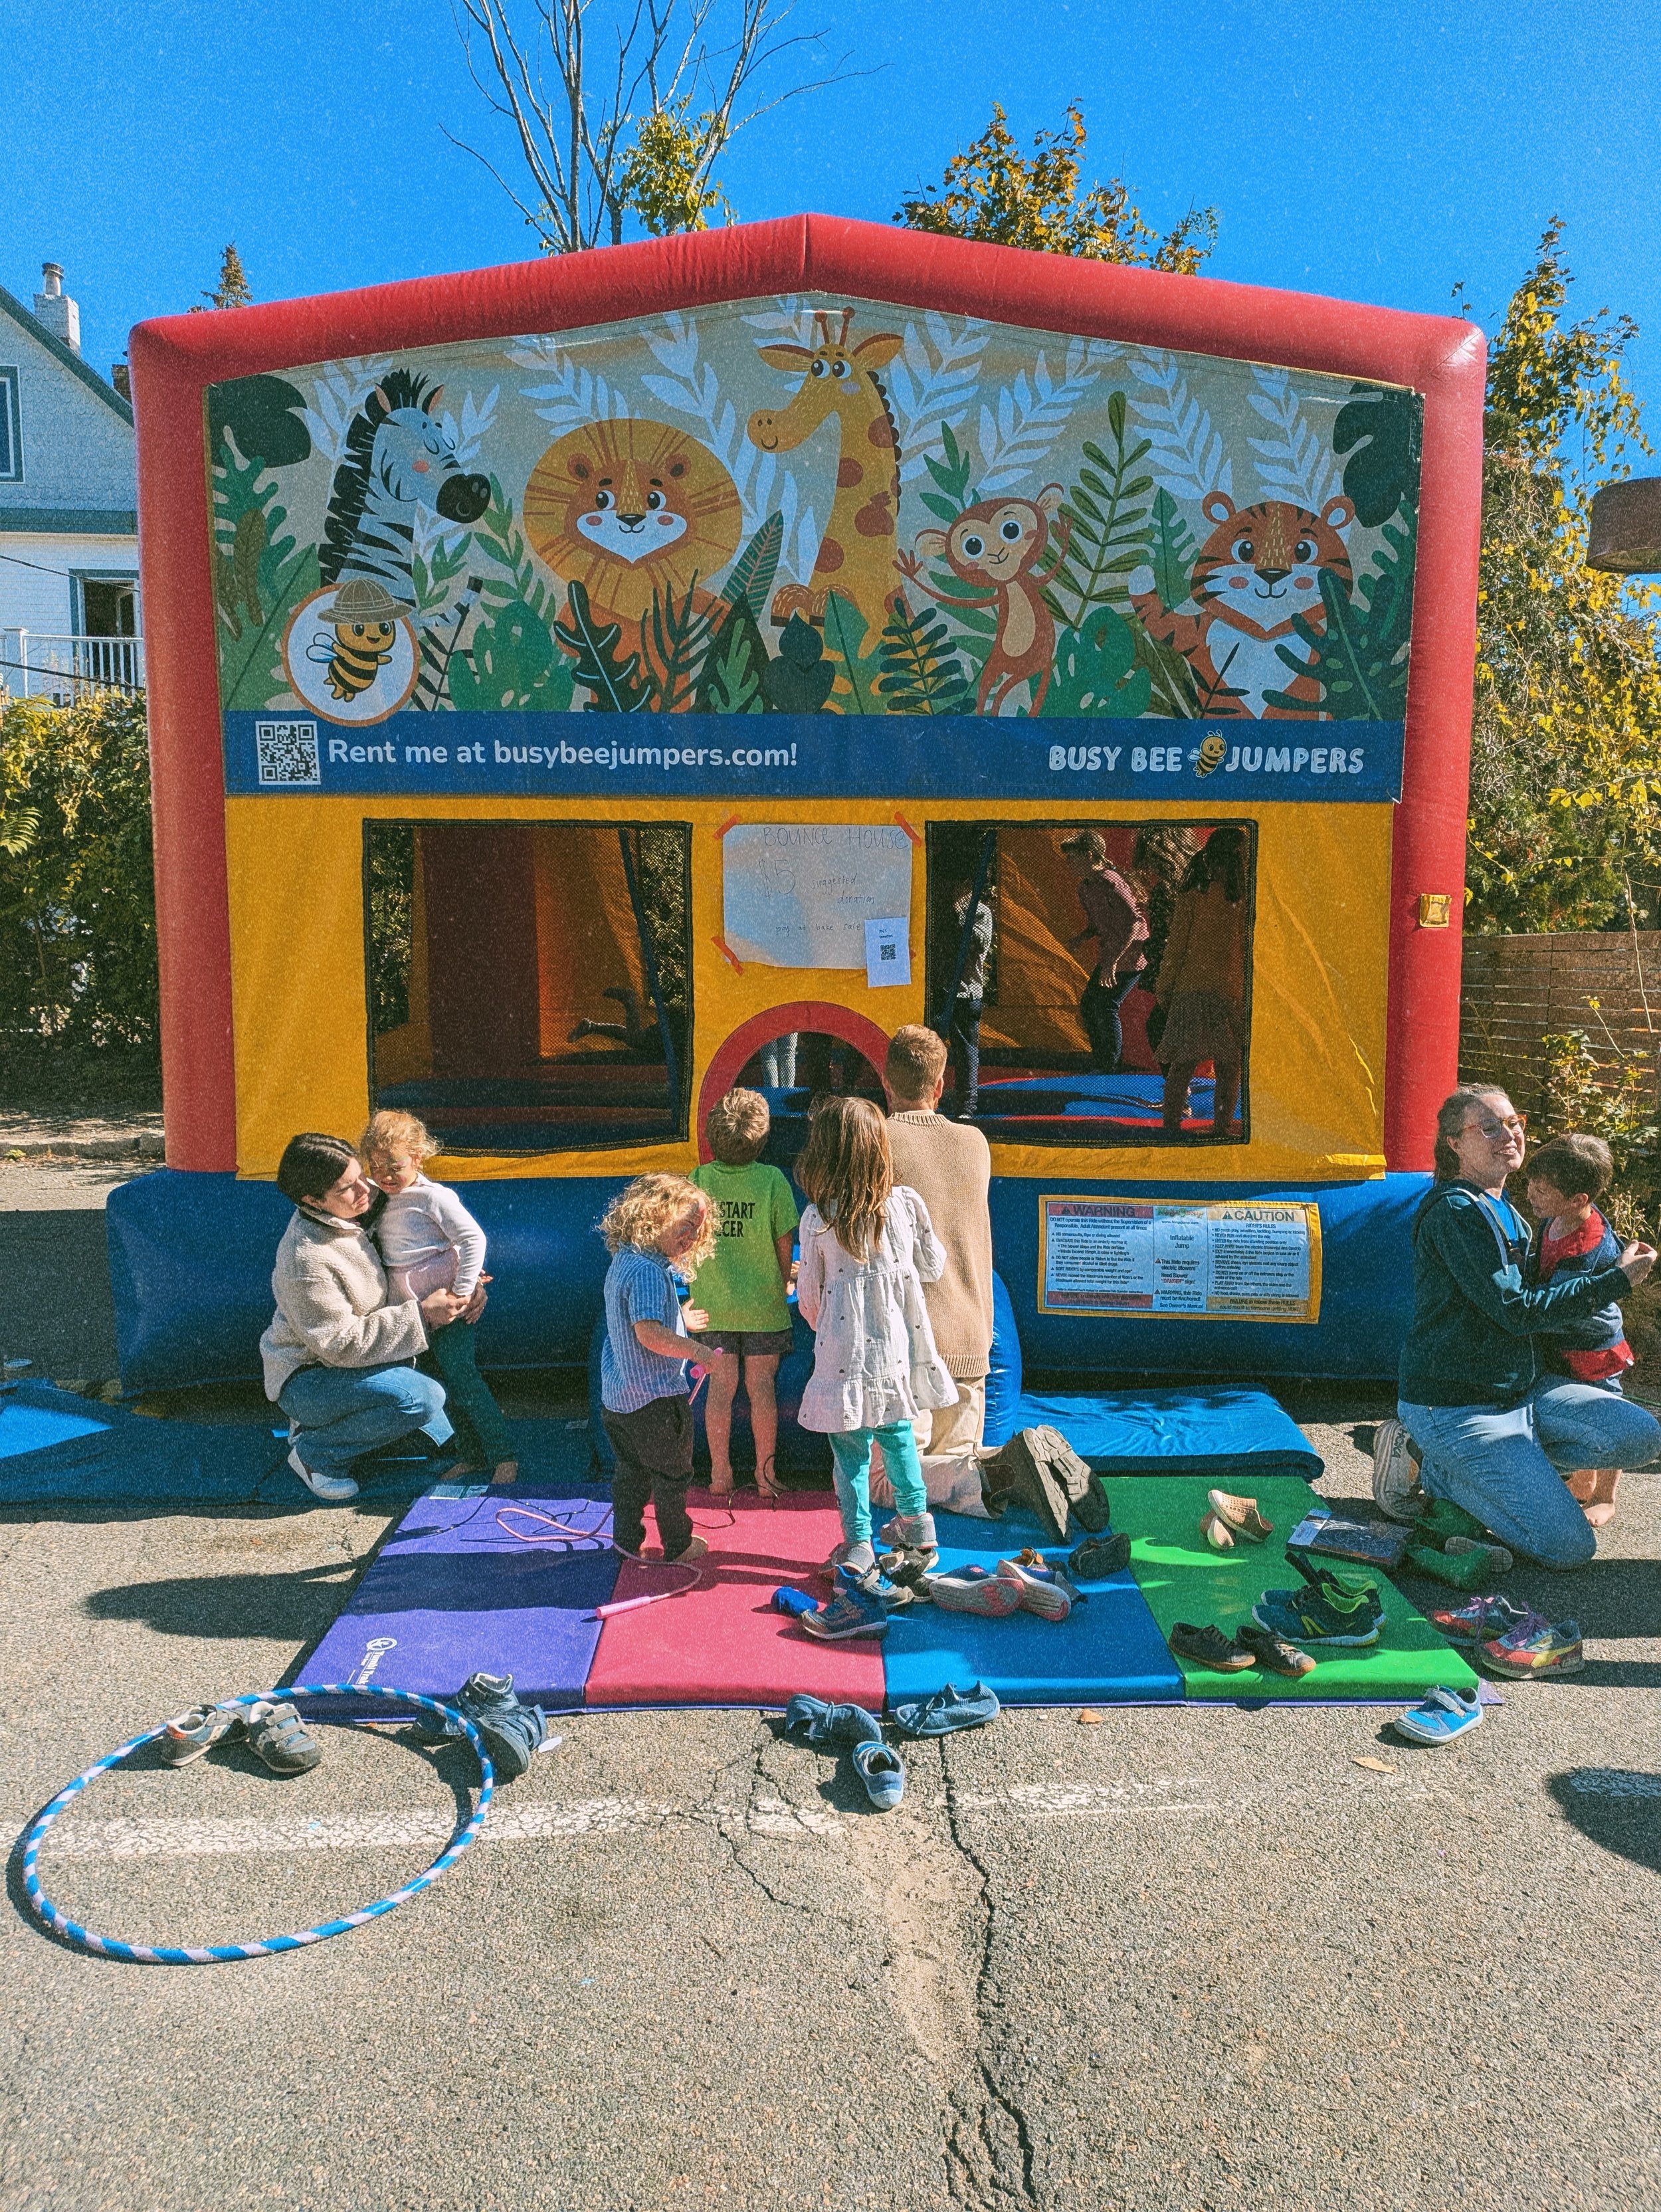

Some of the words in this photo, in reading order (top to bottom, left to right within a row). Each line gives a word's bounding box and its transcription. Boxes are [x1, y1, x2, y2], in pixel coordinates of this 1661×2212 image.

[329, 740, 396, 763] Rent
[406, 746, 448, 763] me
[458, 742, 486, 764] at
[495, 740, 798, 769] busybeejumpers.com!
[1049, 746, 1122, 771] BUSY
[1131, 747, 1183, 771] BEE
[1225, 746, 1364, 773] JUMPERS
[757, 858, 796, 898] $5
[811, 873, 858, 896] suggested
[838, 890, 875, 904] donation
[775, 926, 789, 937] pay
[844, 922, 861, 931] sale
[1074, 1205, 1135, 1217] WARNING
[1234, 1211, 1294, 1222] CAUTION
[1392, 1429, 1408, 1458] HOKA
